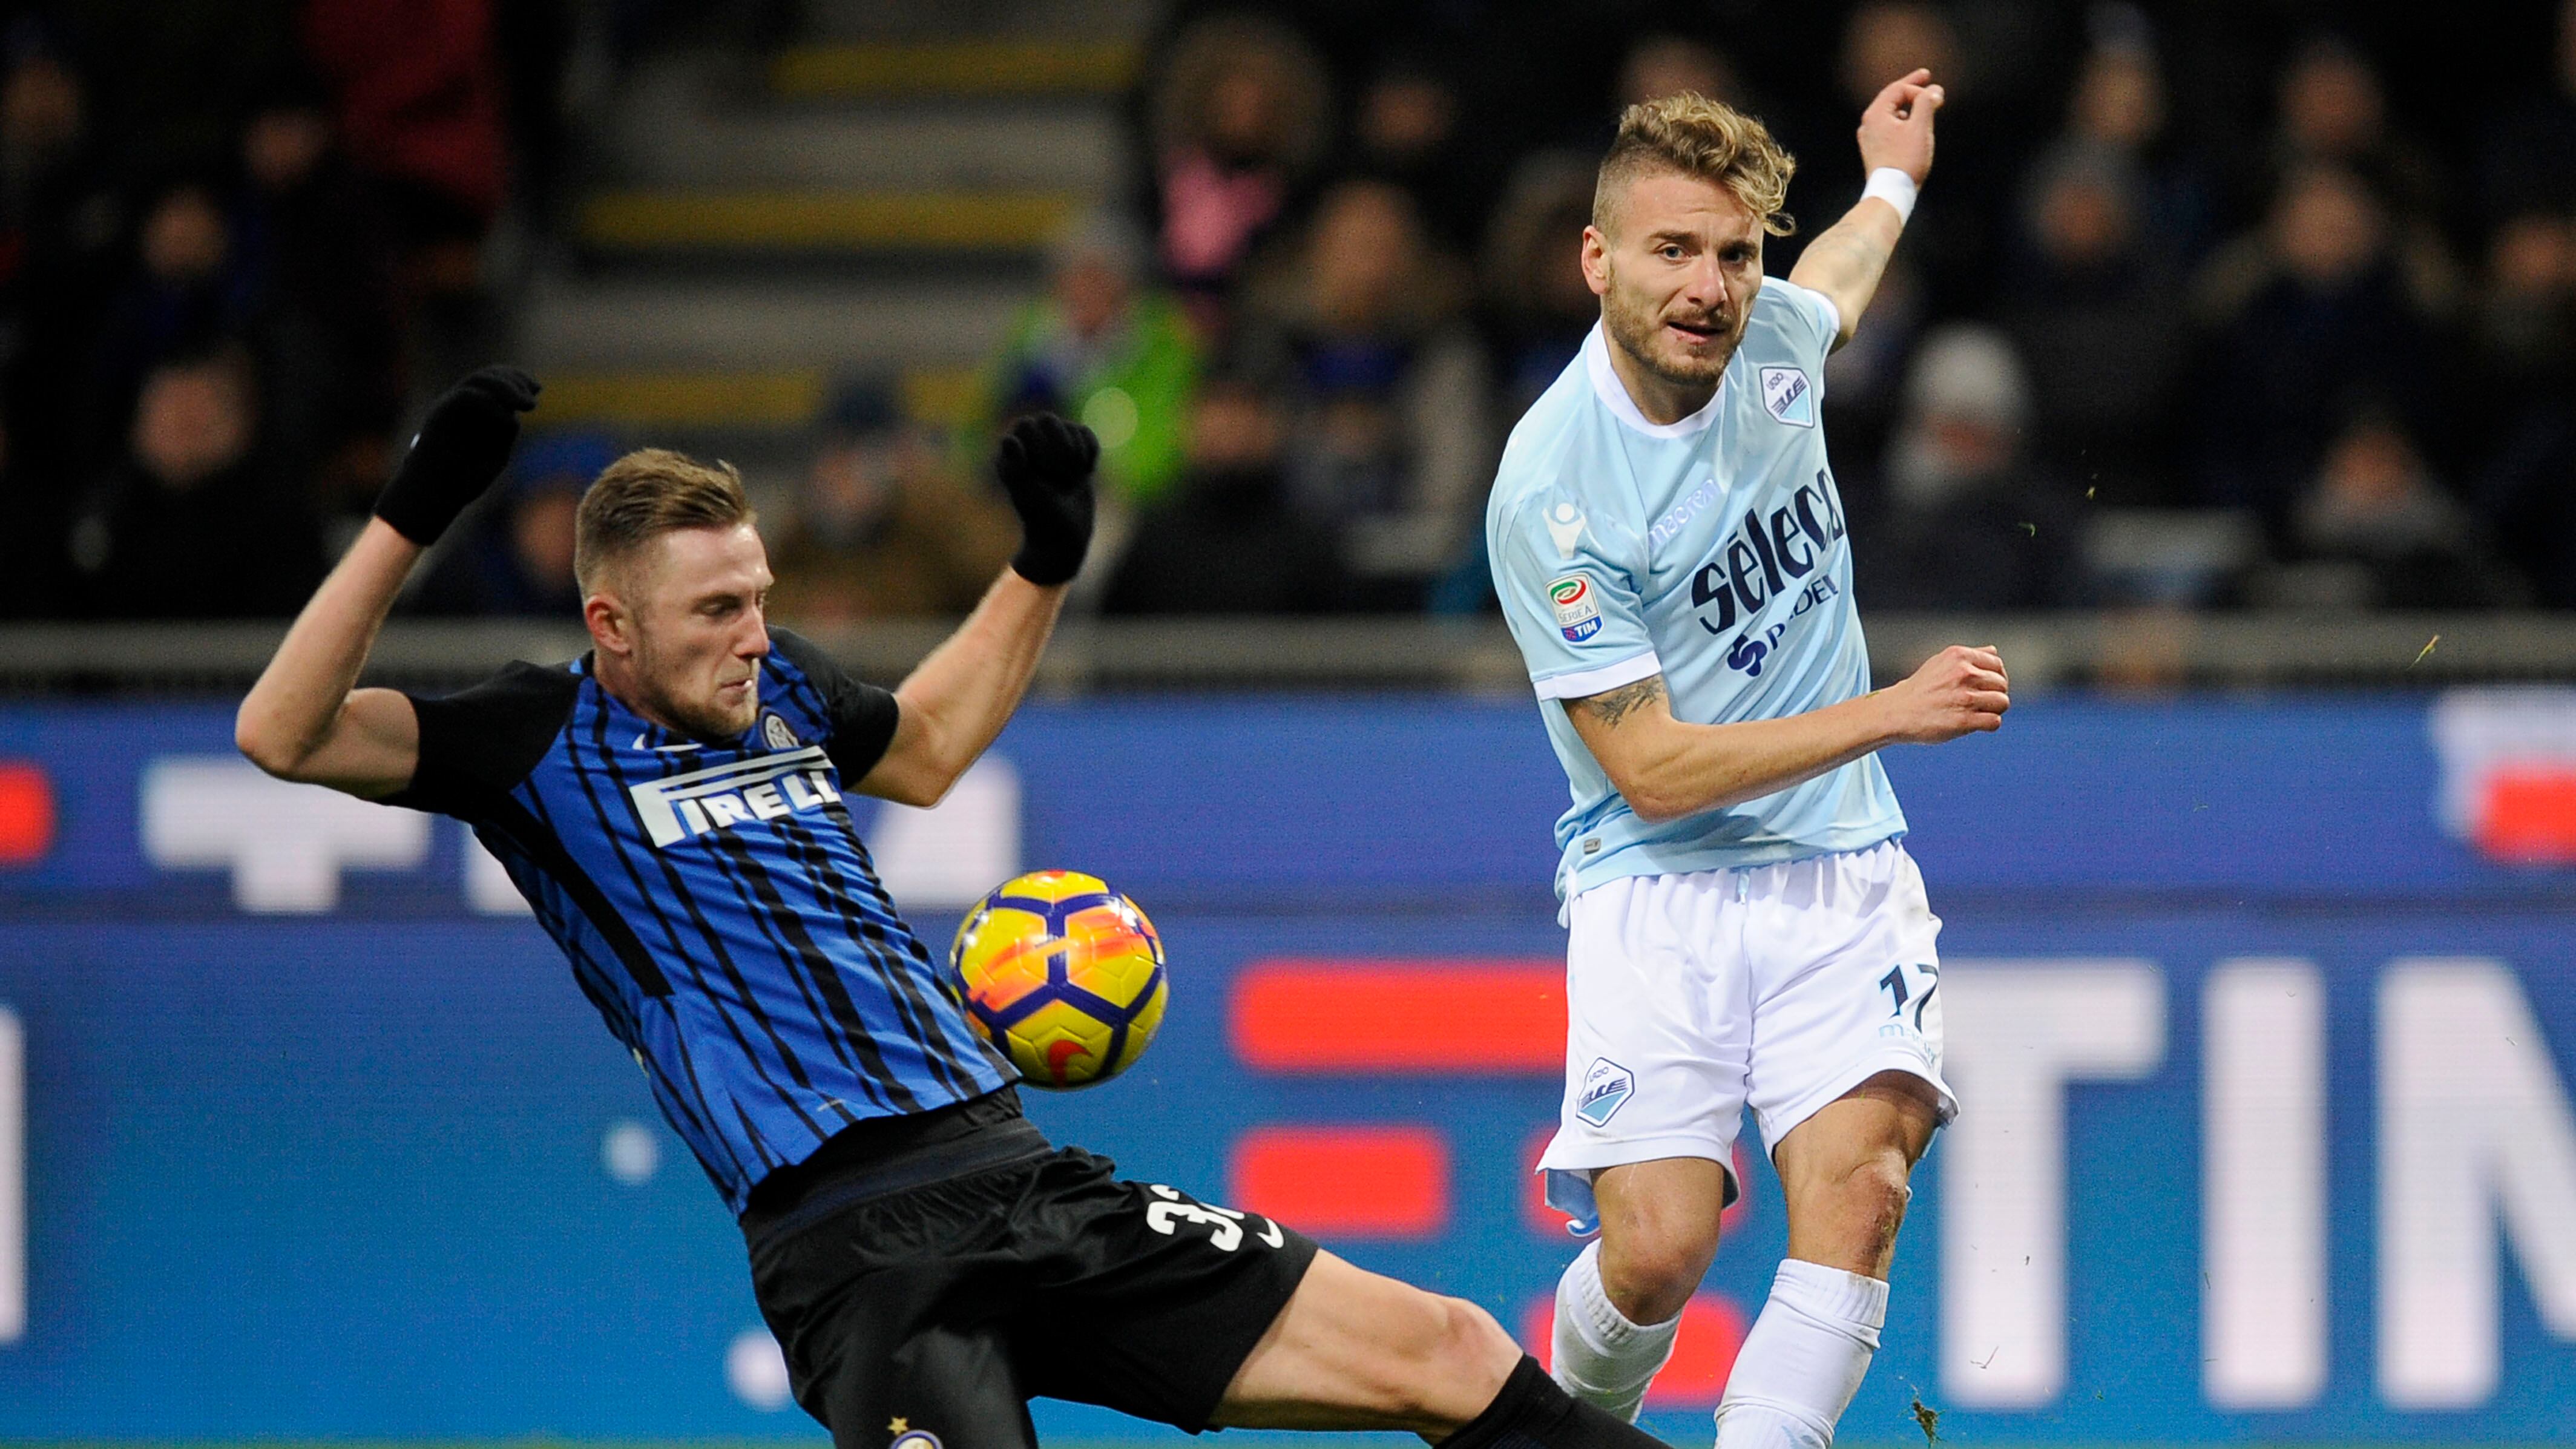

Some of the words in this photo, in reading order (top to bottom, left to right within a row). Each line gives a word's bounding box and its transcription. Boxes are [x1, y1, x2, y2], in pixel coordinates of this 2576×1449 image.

[1585, 605, 1592, 616] A
[1574, 619, 1598, 637] TIM
[629, 745, 842, 847] PIRELL
